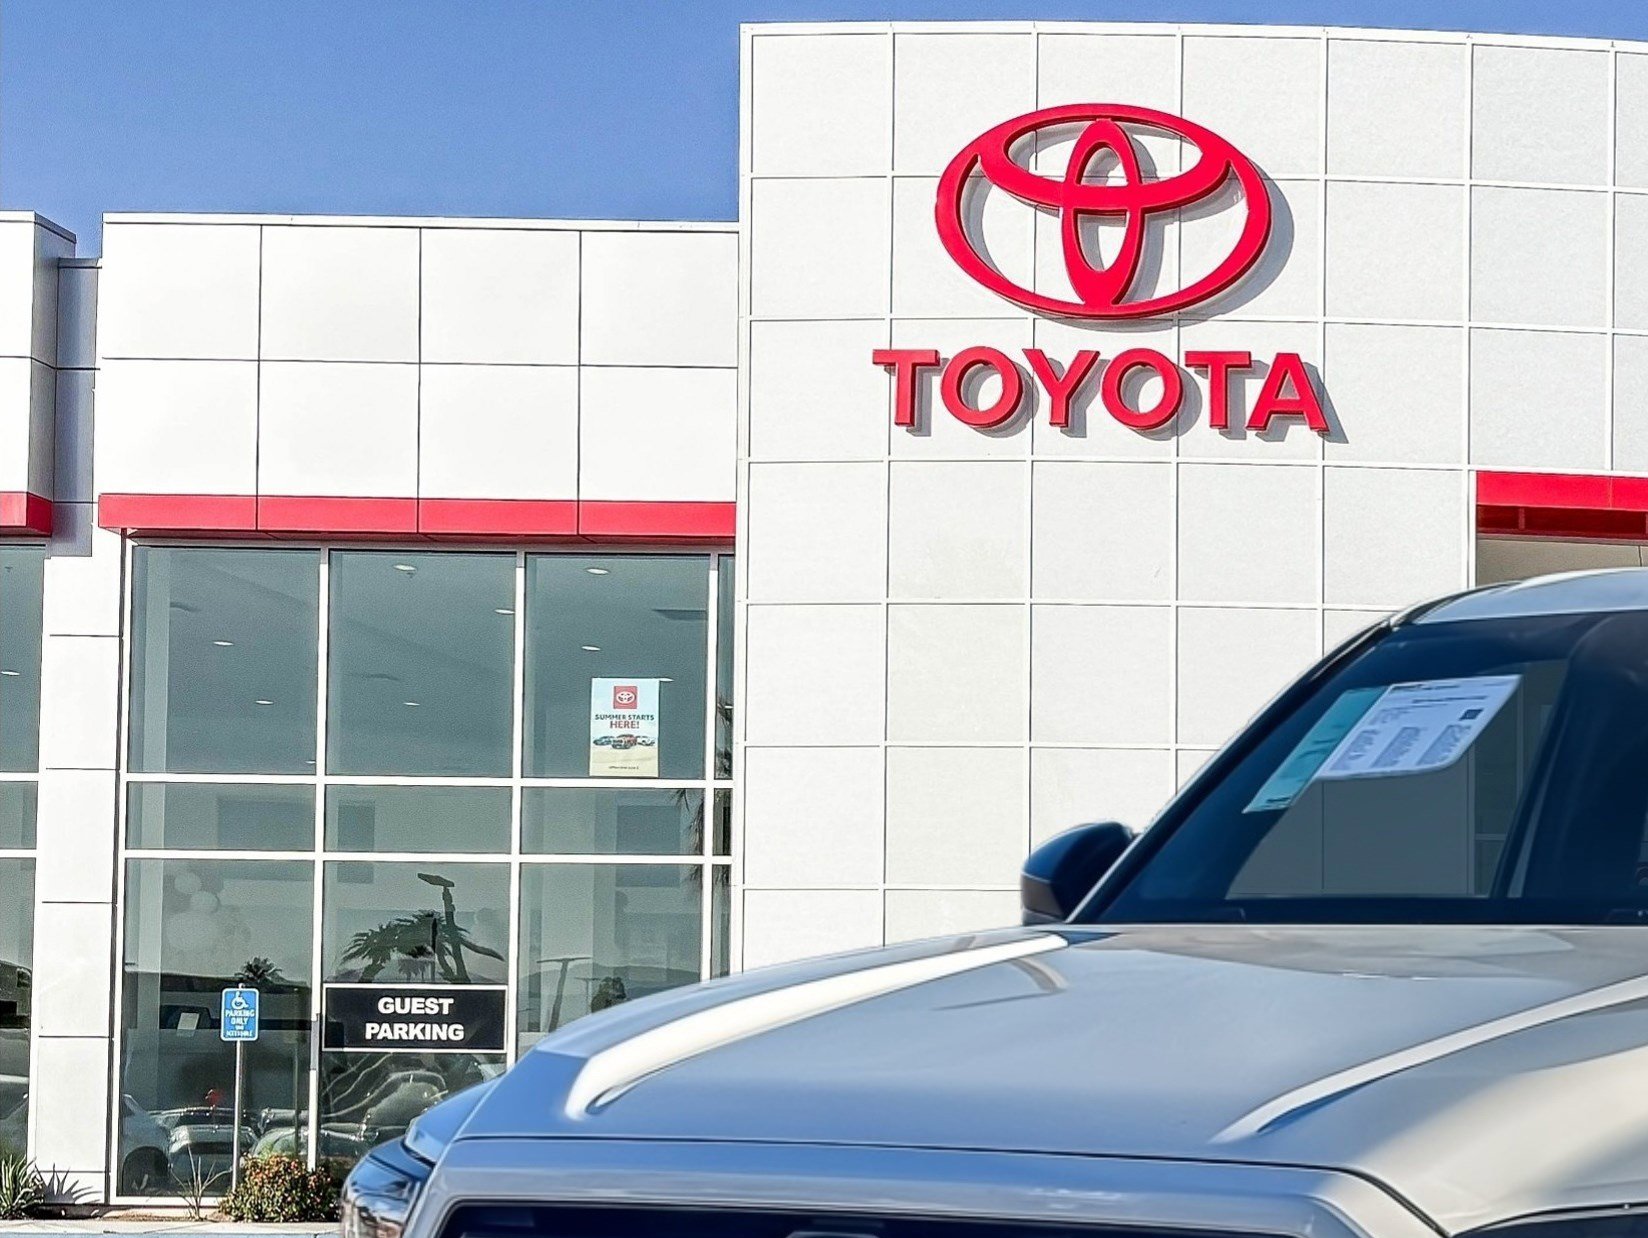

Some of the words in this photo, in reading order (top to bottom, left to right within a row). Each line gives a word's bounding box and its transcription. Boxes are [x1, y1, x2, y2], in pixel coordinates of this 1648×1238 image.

[872, 346, 1330, 432] TOYOTA
[609, 721, 639, 729] HERE!
[377, 997, 455, 1015] GUEST
[364, 1022, 465, 1041] PARKING
